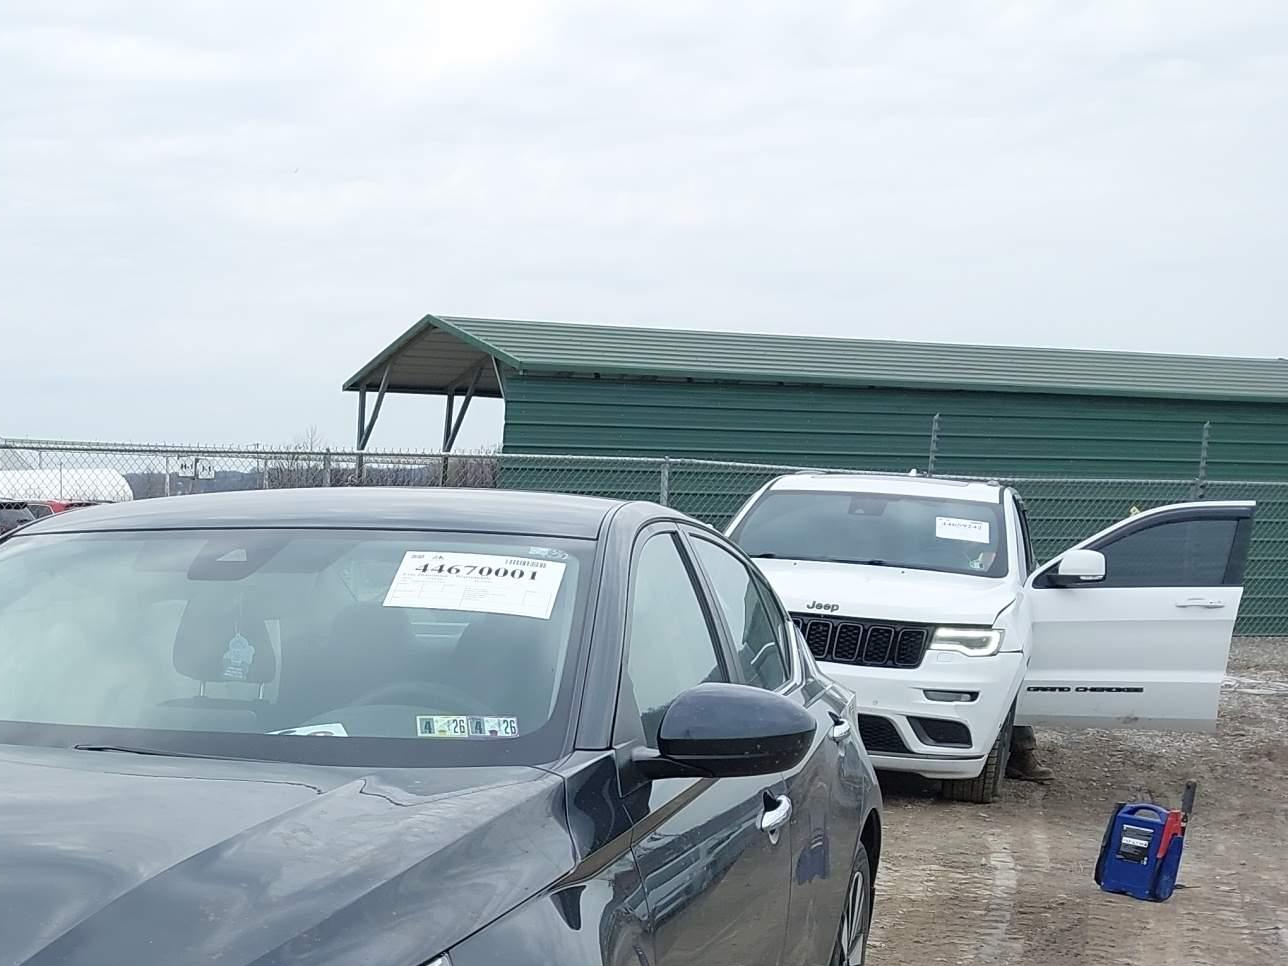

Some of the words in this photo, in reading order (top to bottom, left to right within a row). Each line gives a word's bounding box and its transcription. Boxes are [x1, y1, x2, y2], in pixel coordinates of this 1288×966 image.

[415, 562, 538, 581] 44670001
[806, 600, 840, 613] Jeep
[452, 719, 466, 734] 26
[503, 719, 517, 735] 26
